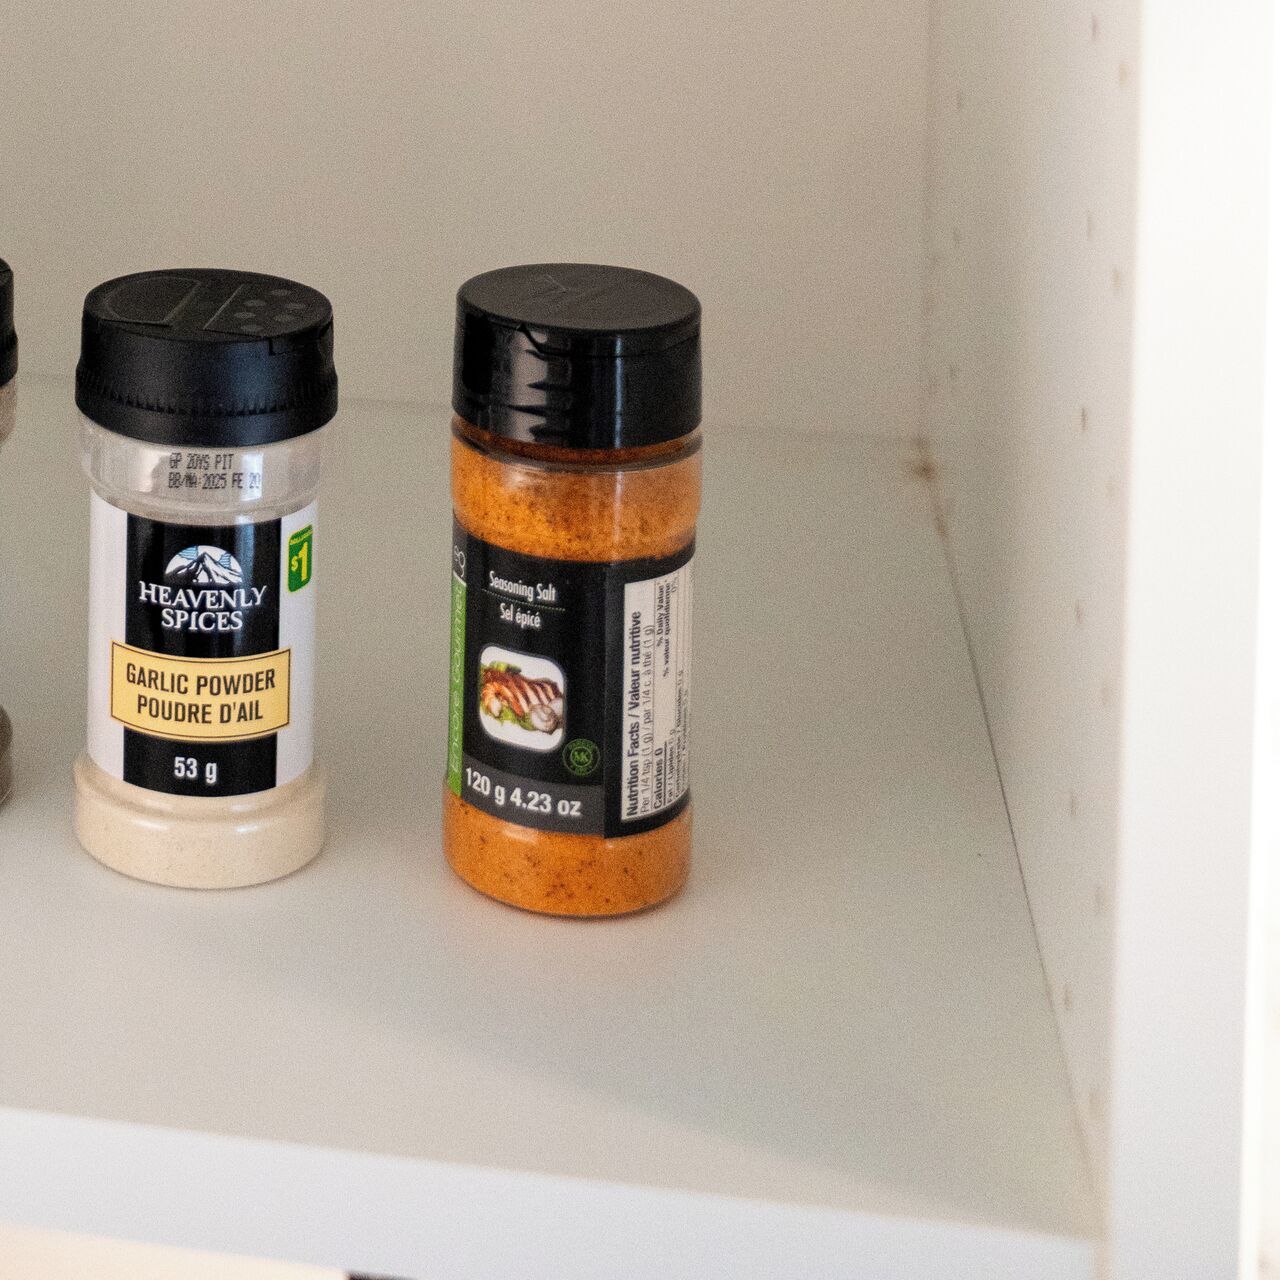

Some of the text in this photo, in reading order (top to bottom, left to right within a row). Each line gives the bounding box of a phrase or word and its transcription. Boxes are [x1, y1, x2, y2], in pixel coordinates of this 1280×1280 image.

[215, 453, 234, 470] PIT
[232, 473, 243, 489] FE
[291, 541, 308, 581] $1
[139, 581, 267, 609] HEAVENLY
[489, 571, 556, 602] Seasoning Salt
[161, 608, 243, 630] SPICES
[500, 603, 540, 628] Sel épicé
[629, 611, 641, 665] nutritive
[126, 662, 275, 696] GARLIC POWDER
[628, 670, 640, 710] Valeur
[138, 694, 263, 724] POUDRE D'AIL
[642, 690, 650, 704] 1/4
[643, 709, 652, 724] par
[628, 722, 639, 757] Facts
[174, 756, 217, 784] 53 g
[642, 759, 652, 775] tsp
[654, 748, 663, 809] Calories 0
[466, 768, 581, 815] 120 g 4.23 oz
[626, 760, 639, 816] Nutrition
[641, 778, 649, 793] 1/4
[641, 797, 649, 813] Per
